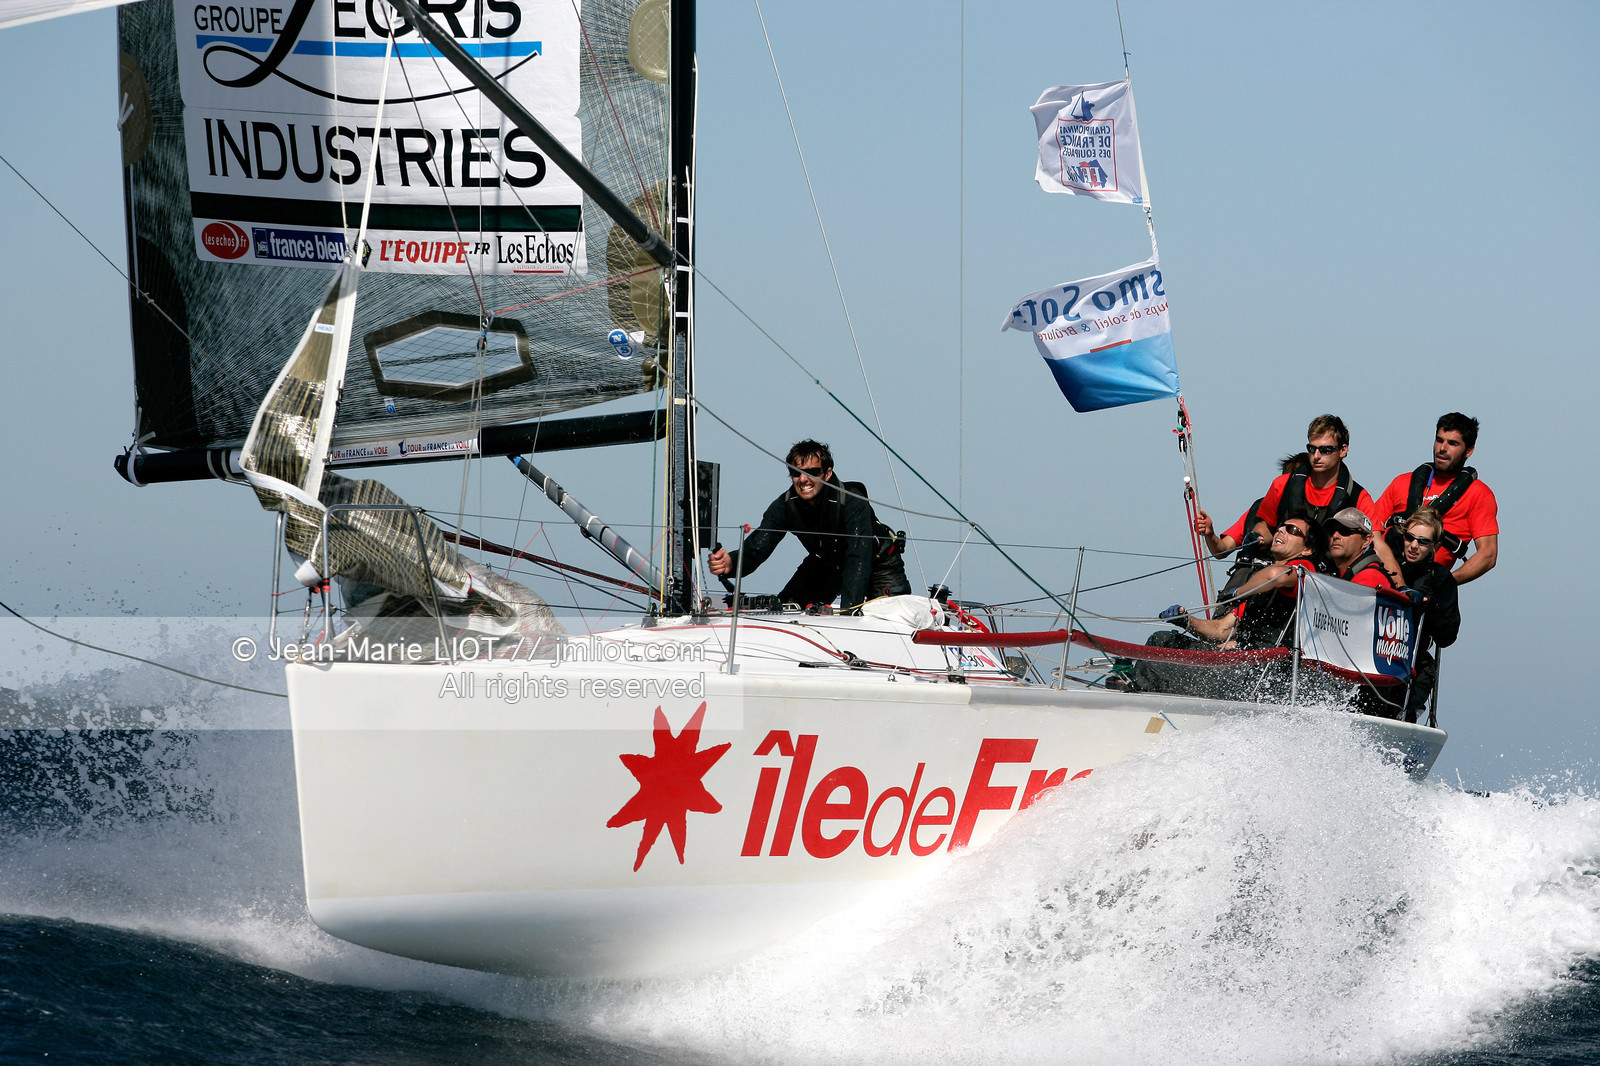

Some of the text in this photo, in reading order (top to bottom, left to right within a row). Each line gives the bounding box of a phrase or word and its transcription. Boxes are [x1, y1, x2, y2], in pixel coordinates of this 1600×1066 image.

[193, 4, 284, 35] GROUPE
[203, 117, 547, 189] INDUSTRIES
[269, 231, 315, 258] france
[314, 234, 345, 261] bleu
[346, 448, 367, 457] FRANCE
[374, 446, 388, 455] VOILE
[407, 444, 422, 452] TOUR
[427, 442, 448, 451] FRANCE
[1378, 606, 1410, 643] Voile
